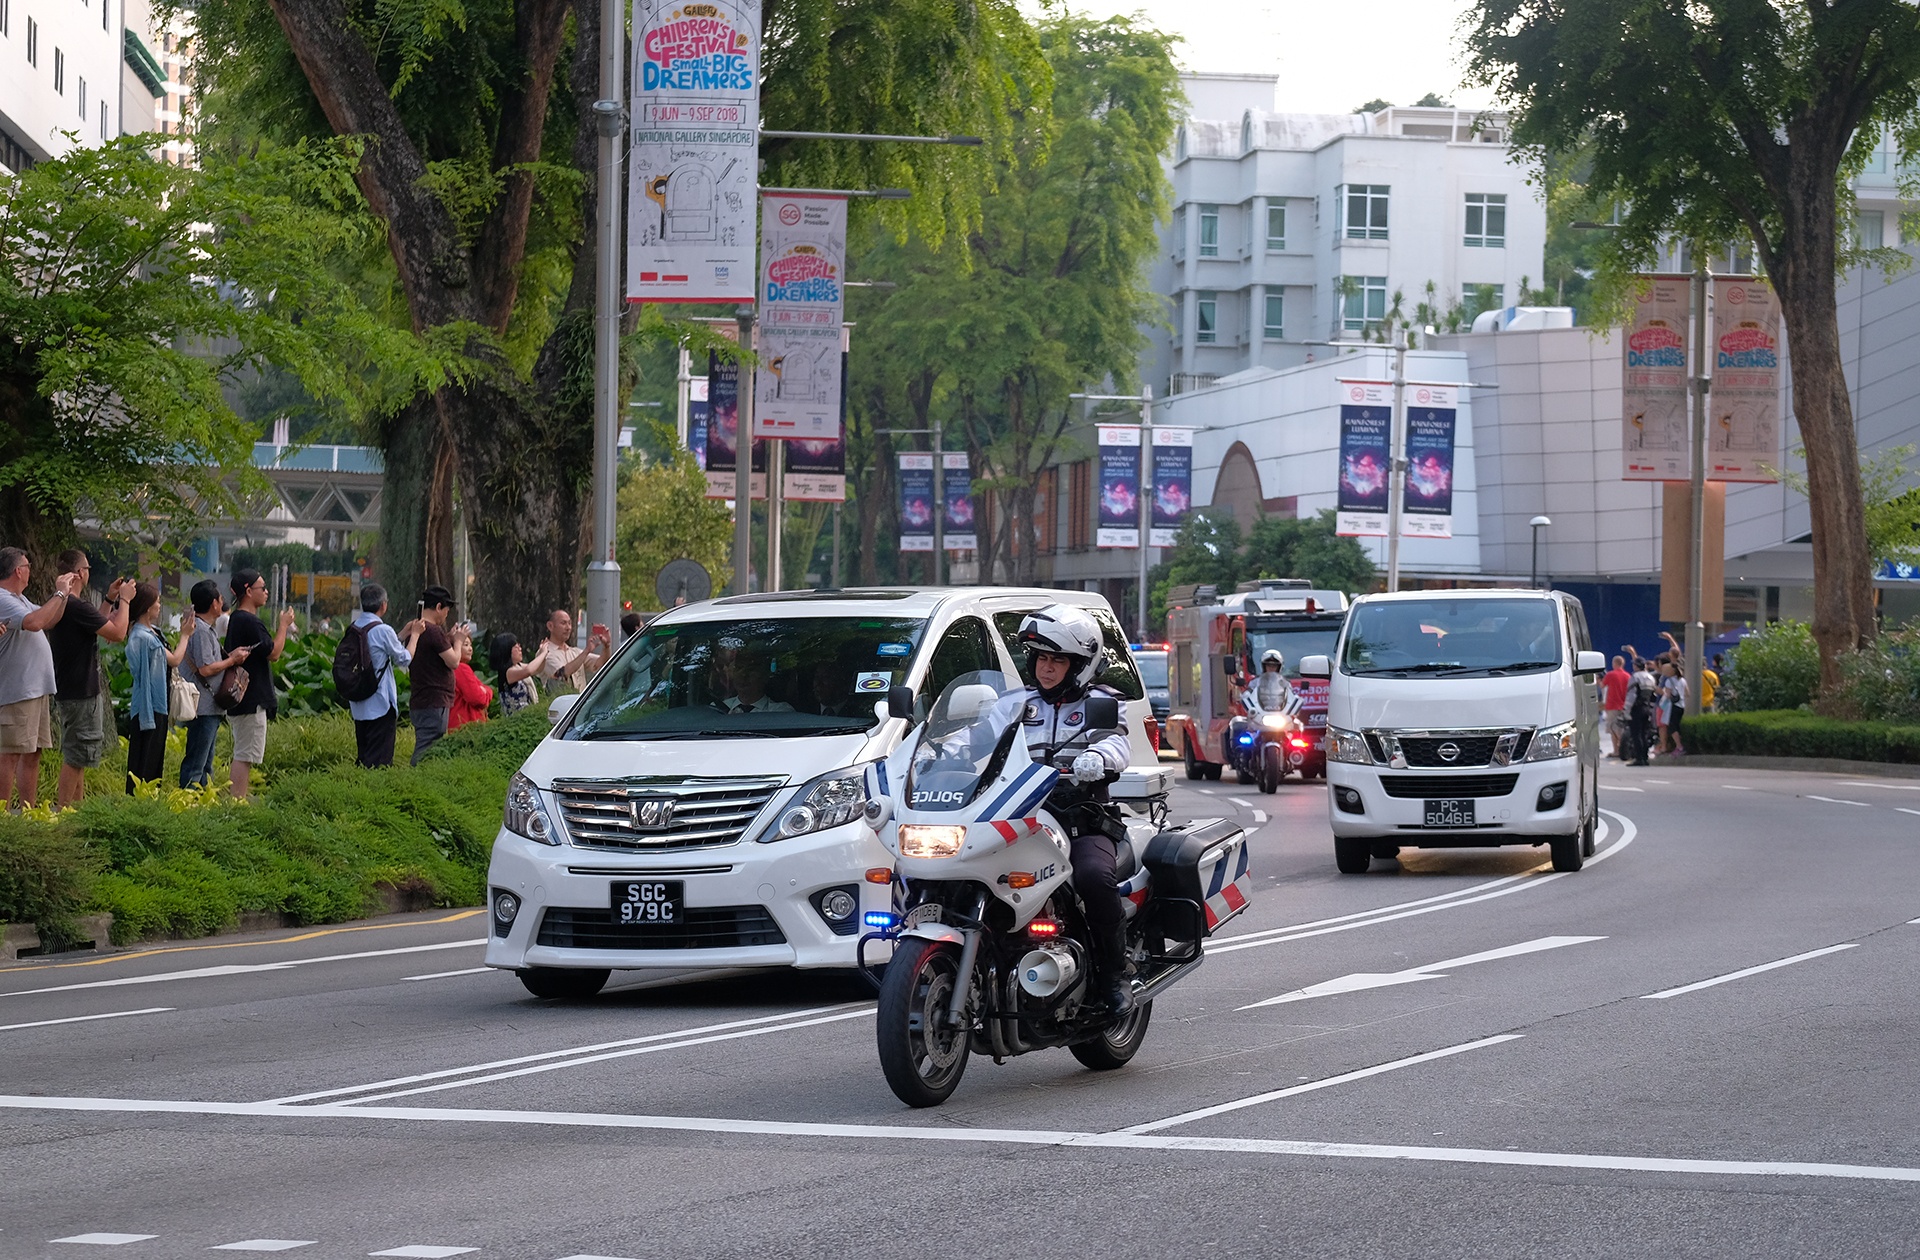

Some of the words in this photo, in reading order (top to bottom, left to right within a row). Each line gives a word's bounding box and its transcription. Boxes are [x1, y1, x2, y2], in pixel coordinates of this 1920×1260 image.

[712, 54, 748, 72] BIG
[652, 107, 658, 120] 9
[658, 107, 679, 120] JUN
[689, 107, 695, 121] 9
[697, 107, 714, 121] SEP
[717, 107, 738, 121] 2018
[638, 131, 673, 142] NATIONAL
[675, 131, 707, 142] GALLERY
[709, 131, 751, 143] SINGAPORE
[782, 210, 798, 220] SG
[804, 205, 828, 213] Passion
[1345, 418, 1386, 426] RAINFOREST
[1411, 420, 1451, 428] RAINFOREST
[1417, 428, 1445, 436] LUMINA
[866, 680, 881, 689] 2
[1440, 800, 1459, 813] PC
[1426, 812, 1473, 824] 5046E
[1031, 863, 1055, 884] LICE
[627, 884, 666, 901] SGC
[621, 902, 673, 920] 979C
